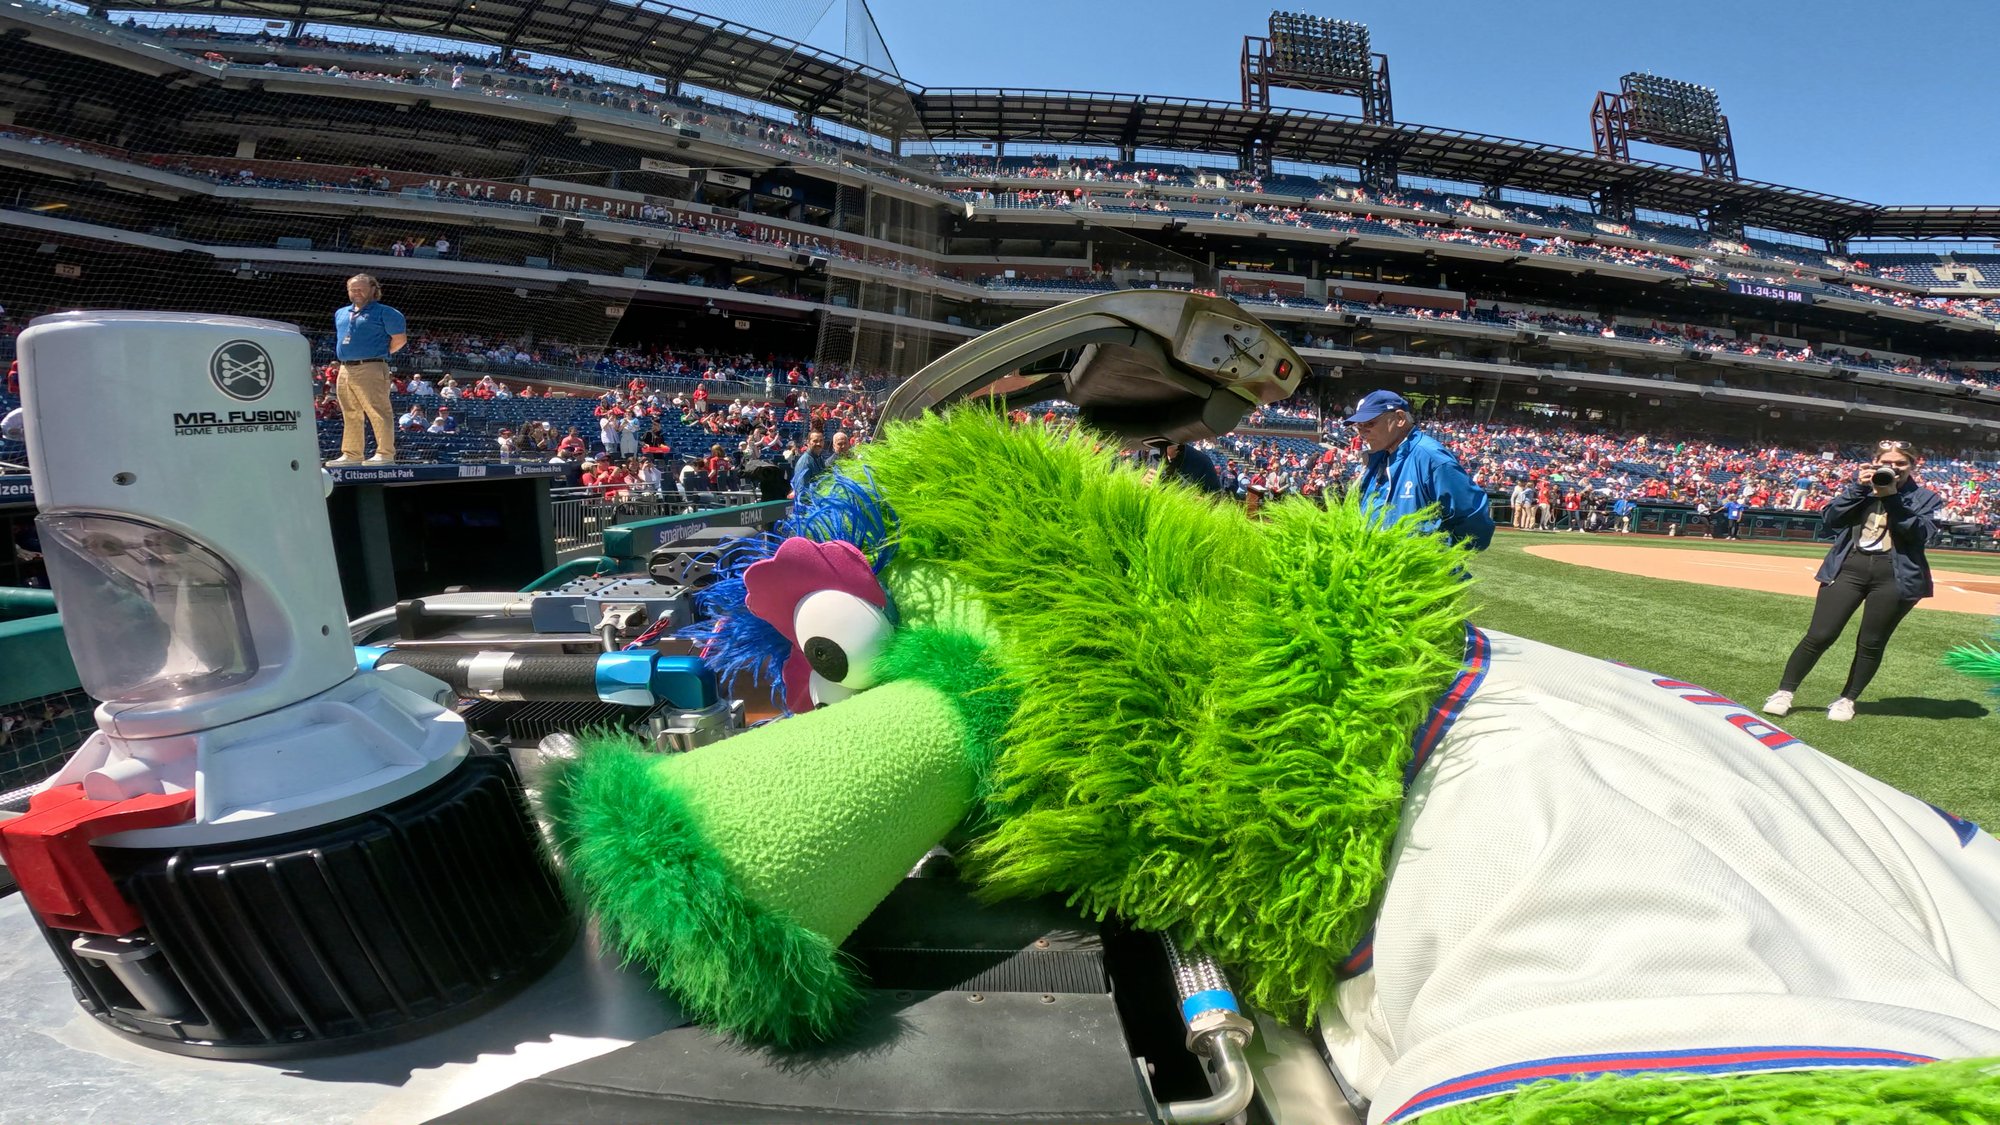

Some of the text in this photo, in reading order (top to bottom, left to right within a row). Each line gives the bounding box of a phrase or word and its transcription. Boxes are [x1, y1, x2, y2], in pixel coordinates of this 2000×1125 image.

[1740, 284, 1802, 302] 11:34:54 AM
[173, 411, 223, 425] MR.
[174, 423, 298, 437] HOME ENERGY REACTOR
[344, 469, 414, 480] Citizens Bank Park
[522, 466, 541, 474] Citizens
[541, 465, 552, 473] Bank
[740, 508, 763, 526] RE/MAX
